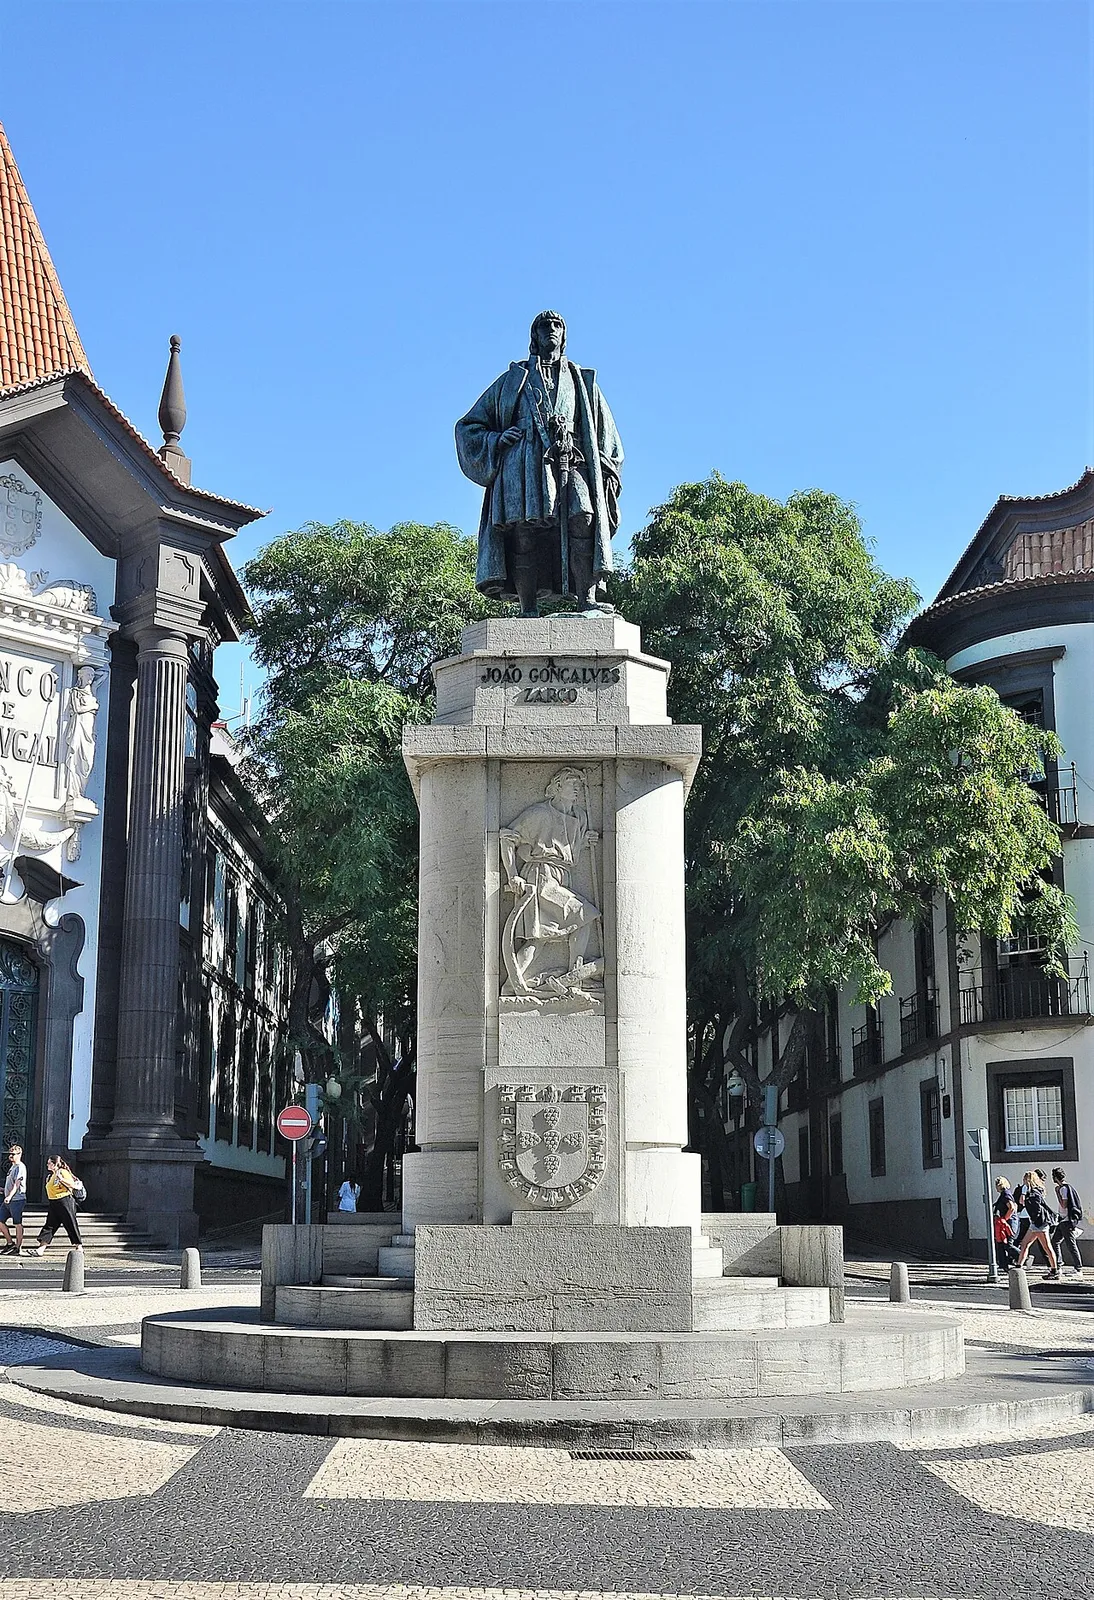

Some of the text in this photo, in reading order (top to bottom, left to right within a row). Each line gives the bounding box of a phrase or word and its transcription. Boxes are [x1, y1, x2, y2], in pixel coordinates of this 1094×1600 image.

[480, 664, 620, 685] JOÃO GONÇALVES
[523, 687, 578, 704] ZARCO
